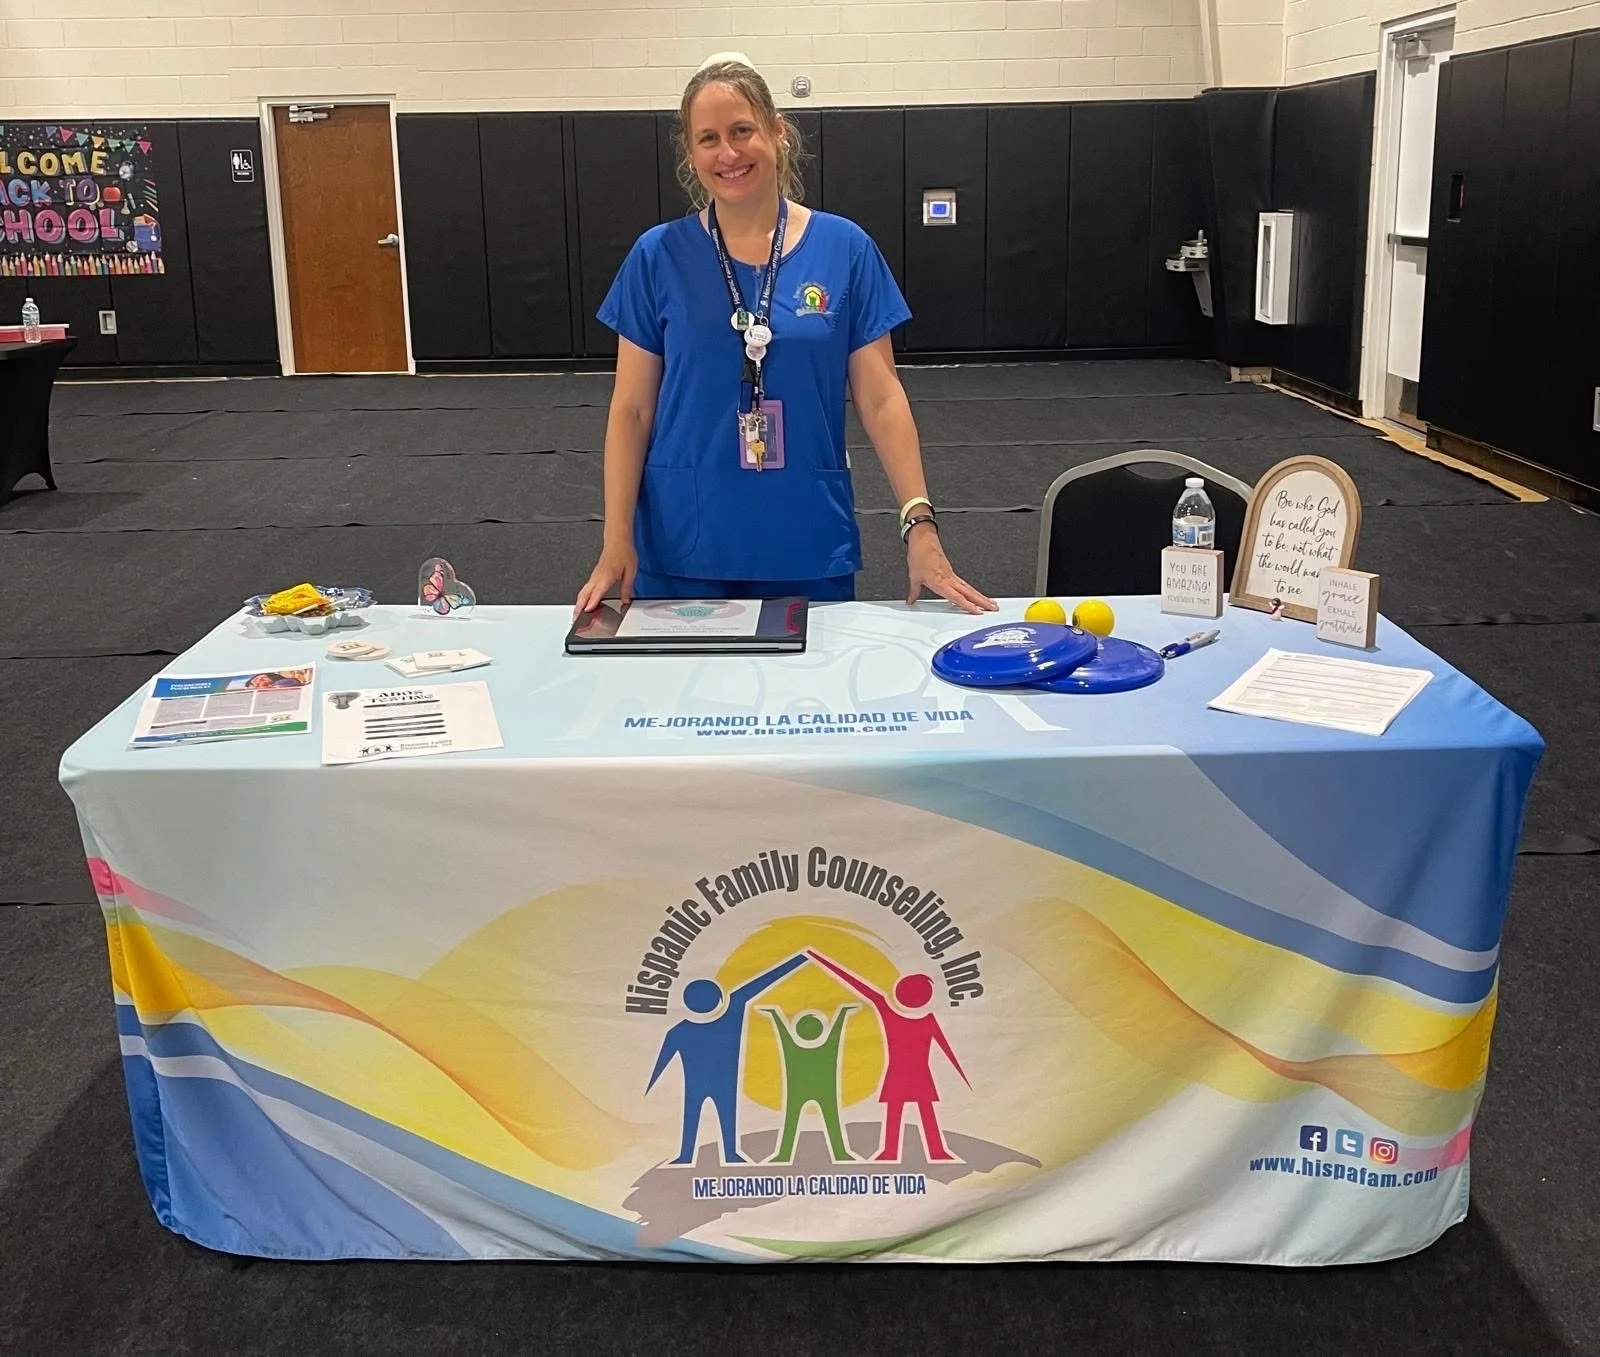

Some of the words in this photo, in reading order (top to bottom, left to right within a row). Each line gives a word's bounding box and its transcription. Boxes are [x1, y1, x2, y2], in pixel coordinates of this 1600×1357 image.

[59, 177, 100, 205] TO
[0, 208, 124, 243] HOOL
[1275, 490, 1294, 509] Be
[1295, 494, 1315, 511] who
[1317, 496, 1340, 518] God
[1269, 511, 1285, 528] has
[1288, 516, 1320, 535] called
[1319, 527, 1336, 542] you
[1262, 533, 1275, 547] to
[1292, 540, 1312, 556] not
[1309, 543, 1338, 560] what
[1169, 561, 1186, 574] YOU
[1191, 563, 1208, 577] ARE
[1256, 552, 1273, 568] the
[1274, 559, 1303, 577] world
[1274, 579, 1286, 593] to
[1330, 579, 1359, 591] INHALE
[1321, 590, 1365, 606] grace
[1327, 605, 1357, 617] EXHALE
[624, 715, 758, 728] MEJORANDO
[765, 714, 791, 726] LA
[798, 712, 887, 725] CALIDAD
[892, 711, 919, 723] DE
[924, 710, 974, 722] VIDA
[696, 725, 908, 736] www.hispafam.com
[625, 898, 712, 1015] Hispanic
[694, 849, 799, 915] Family
[807, 846, 964, 960] Counseling,
[940, 950, 984, 1007] Inc.
[1249, 1157, 1438, 1188] www.hispafam.com
[694, 1177, 784, 1198] MEJORANDO
[788, 1177, 805, 1196] LA
[810, 1176, 867, 1195] CALIDAD
[872, 1176, 890, 1195] DE
[894, 1175, 926, 1195] VIDA
